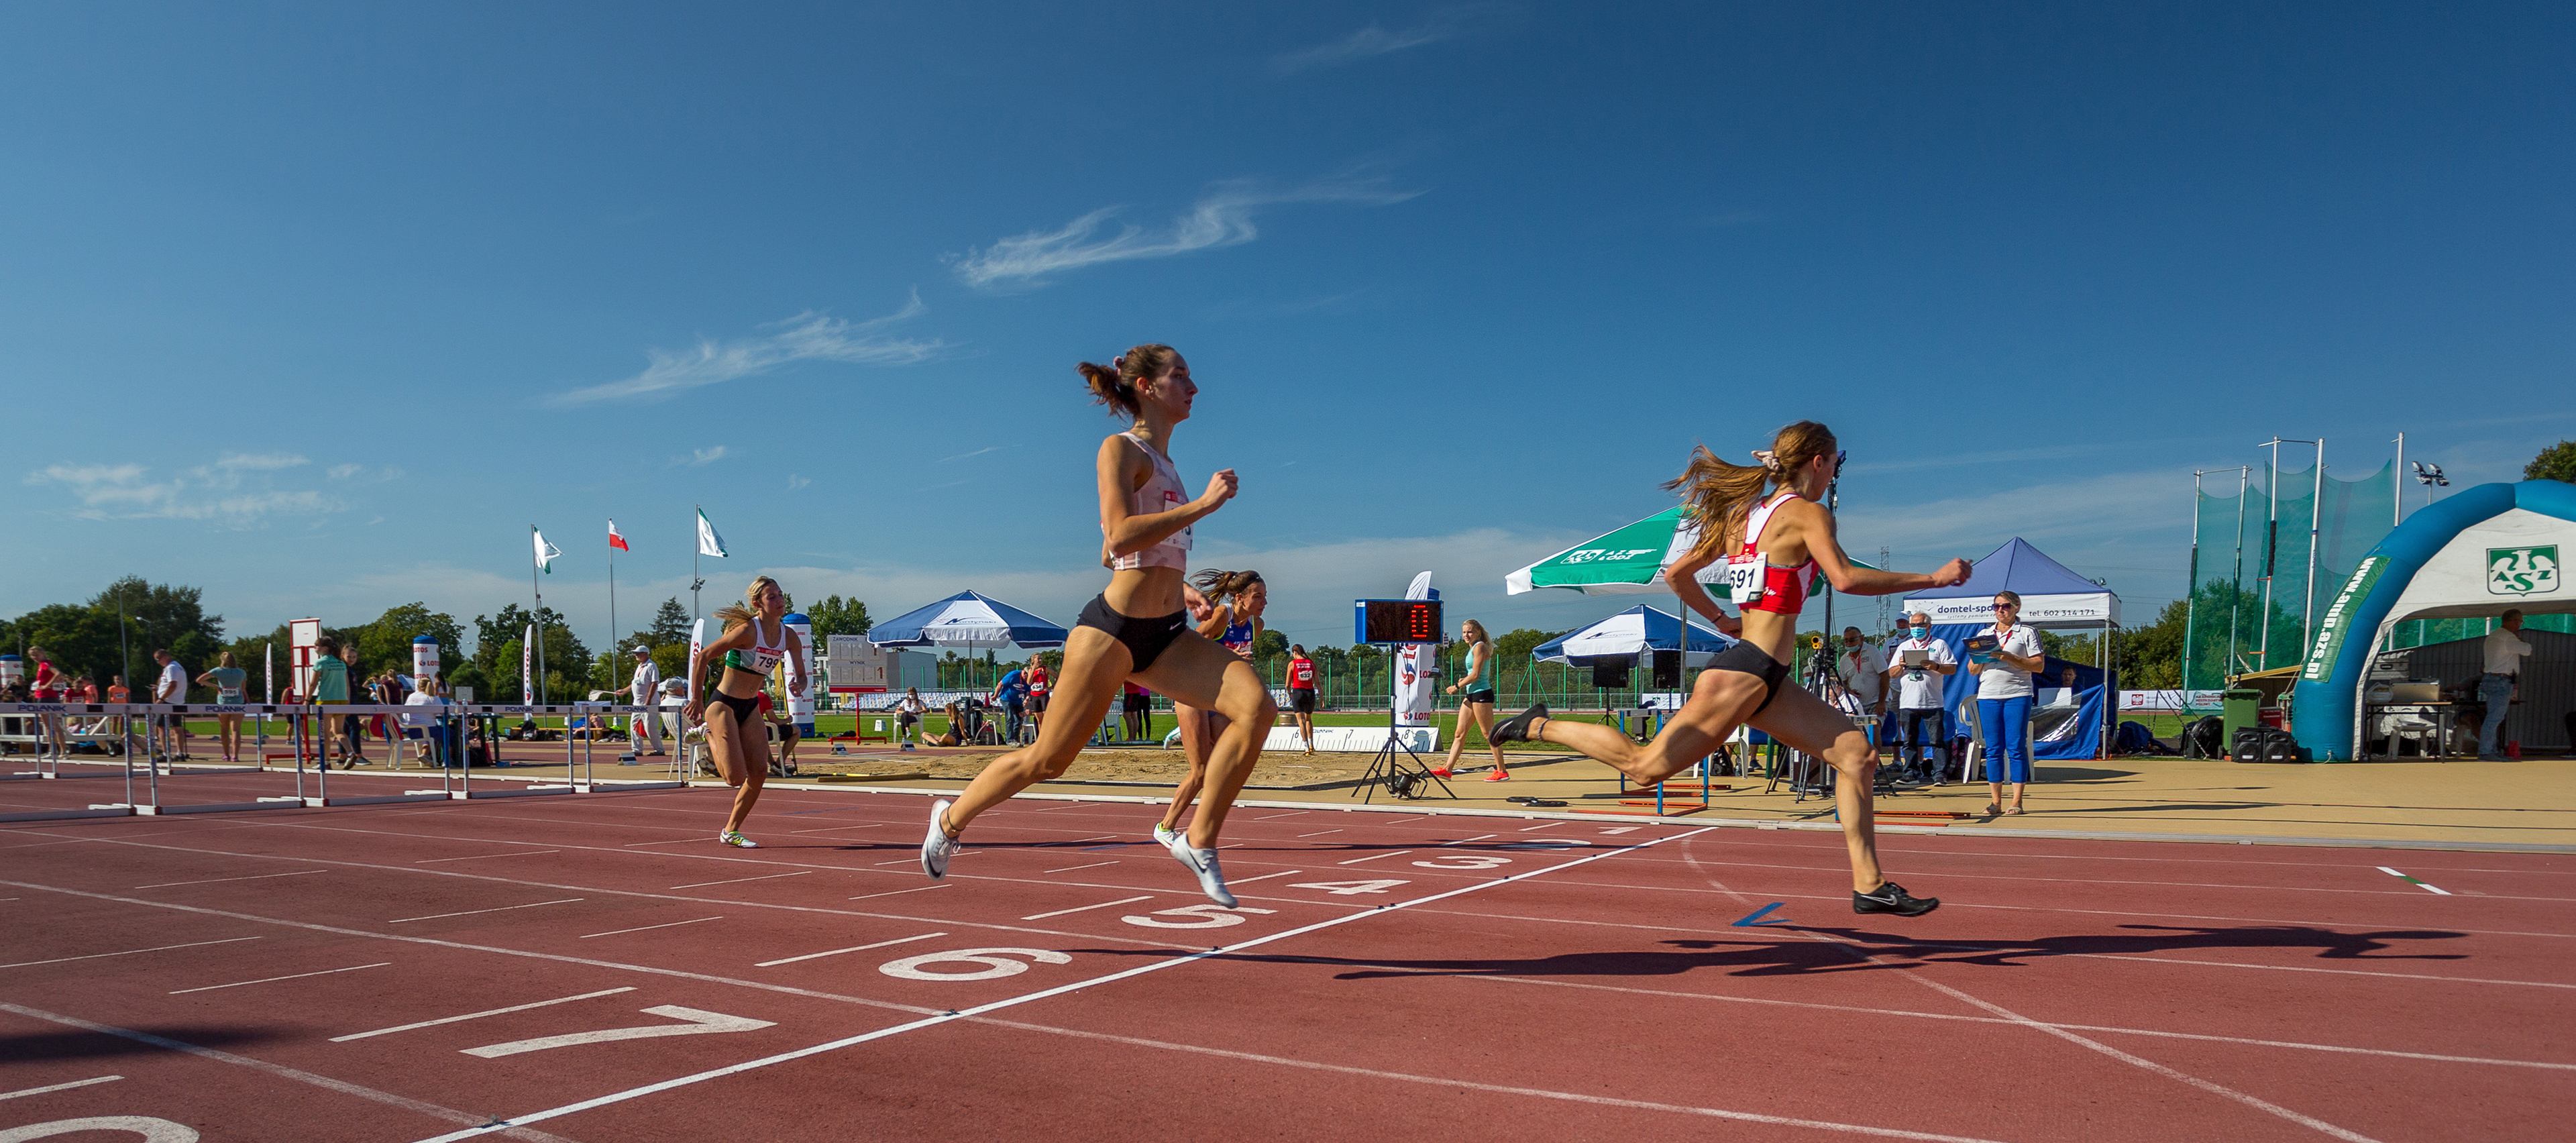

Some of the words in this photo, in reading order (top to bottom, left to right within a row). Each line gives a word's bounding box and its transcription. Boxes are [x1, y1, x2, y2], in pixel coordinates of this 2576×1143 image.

[1729, 568, 1756, 590] 691
[1937, 604, 1994, 613] domtel-spo
[2304, 557, 2377, 679] www.amp.azs.pl
[759, 655, 779, 669] 799
[877, 667, 883, 679] 1
[1295, 729, 1299, 739] 6
[1348, 729, 1354, 739] 7
[1404, 730, 1410, 739] 8
[1411, 855, 1513, 869] 3
[1285, 879, 1411, 895] 4
[1121, 904, 1279, 928] 5
[879, 947, 1073, 981] 6
[458, 1004, 778, 1058] 7
